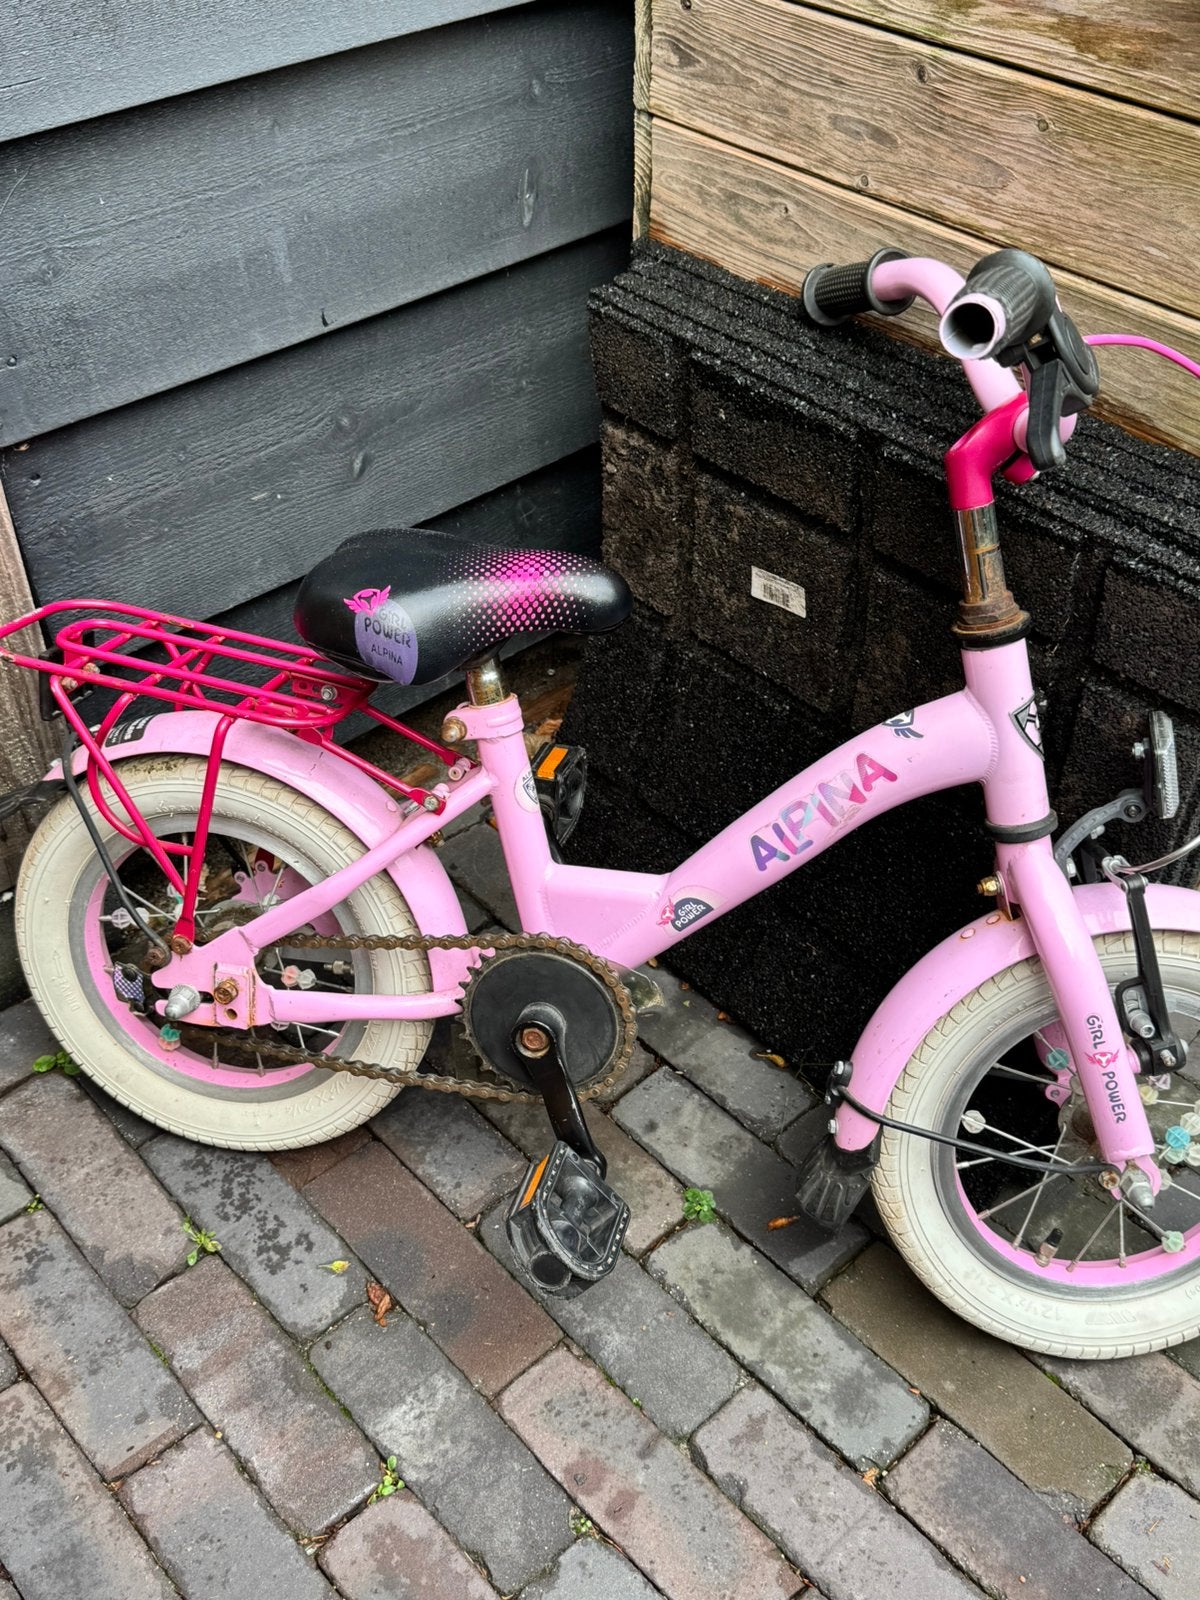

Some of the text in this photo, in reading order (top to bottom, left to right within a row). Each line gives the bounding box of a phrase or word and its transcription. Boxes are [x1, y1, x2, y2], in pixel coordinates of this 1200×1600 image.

[364, 617, 411, 648] POWER
[371, 644, 403, 665] ALPINA
[750, 753, 898, 872] ALPINA
[674, 904, 707, 928] POWER
[1101, 1070, 1127, 1124] POWER
